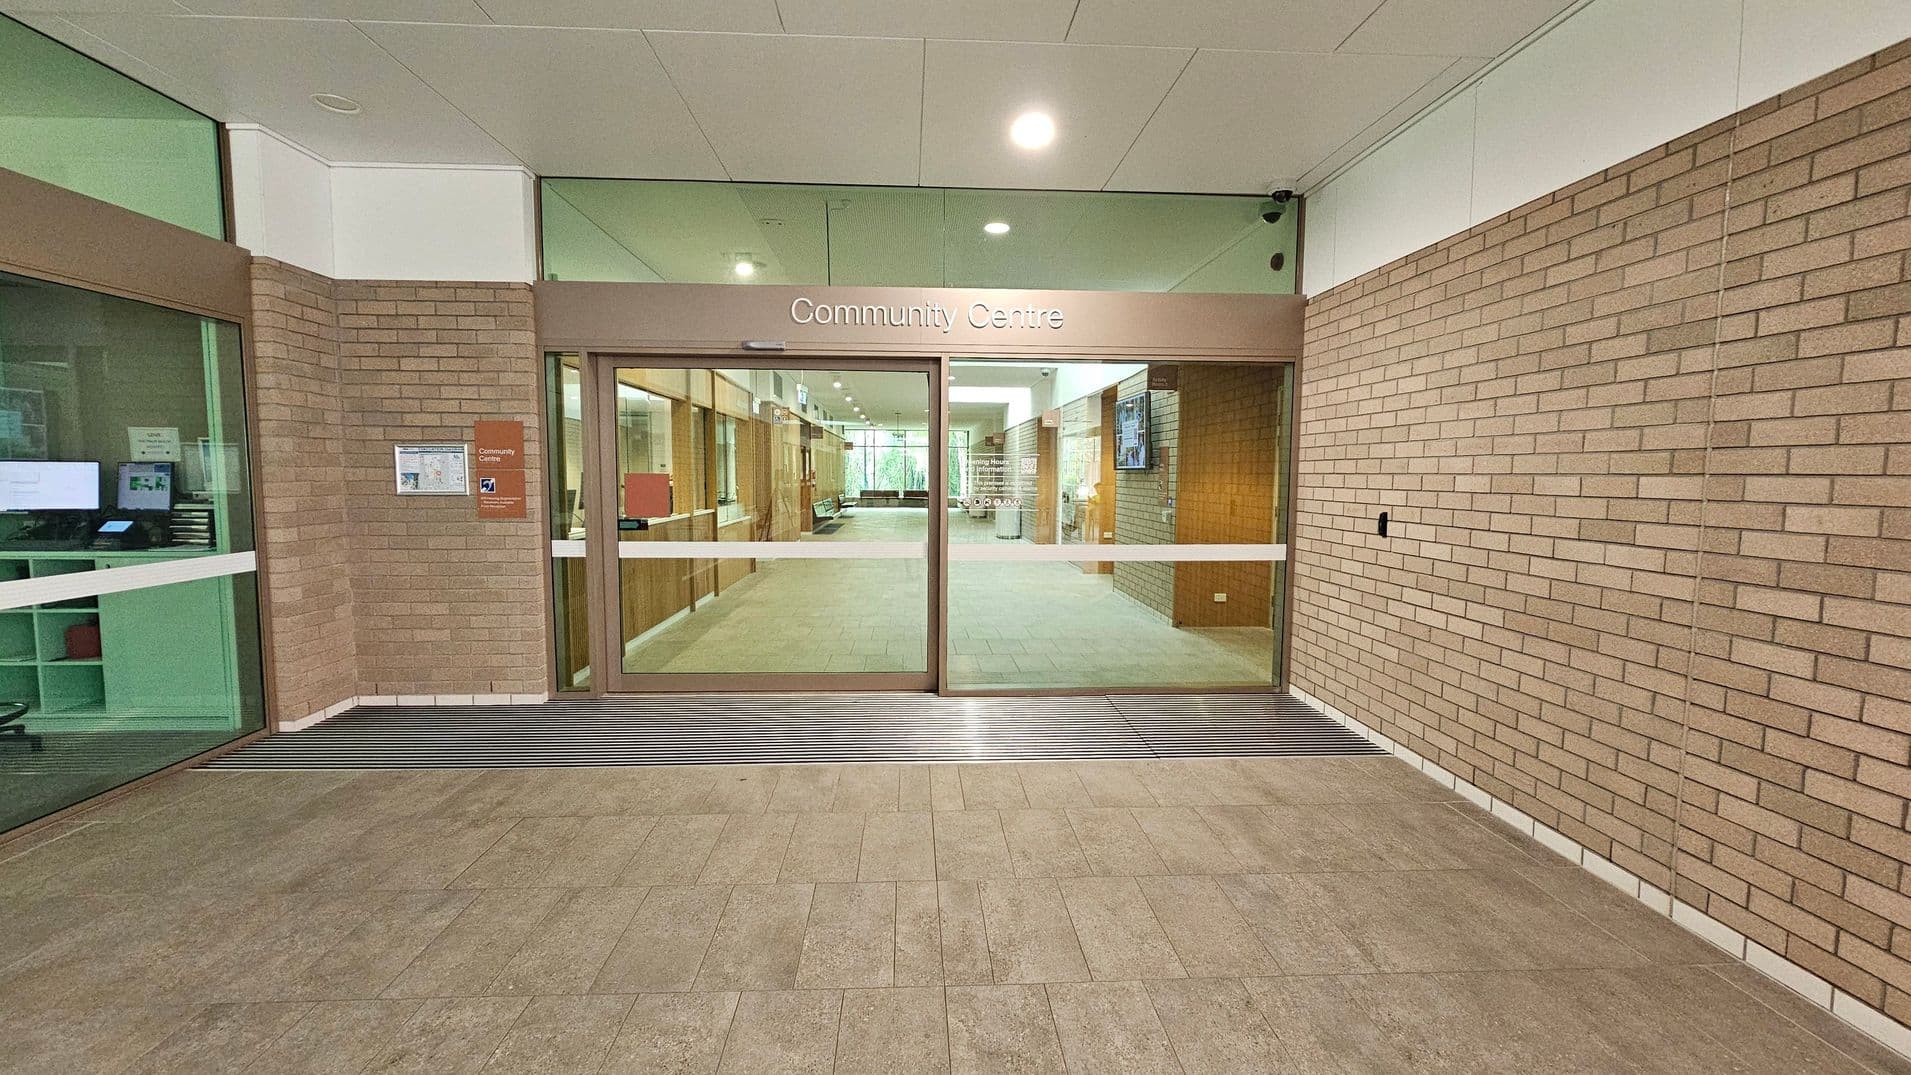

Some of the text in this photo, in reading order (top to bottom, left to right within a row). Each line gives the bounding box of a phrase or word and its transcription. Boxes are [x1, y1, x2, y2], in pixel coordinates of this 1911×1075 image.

[790, 297, 1064, 333] Community Centre
[478, 447, 515, 456] Community
